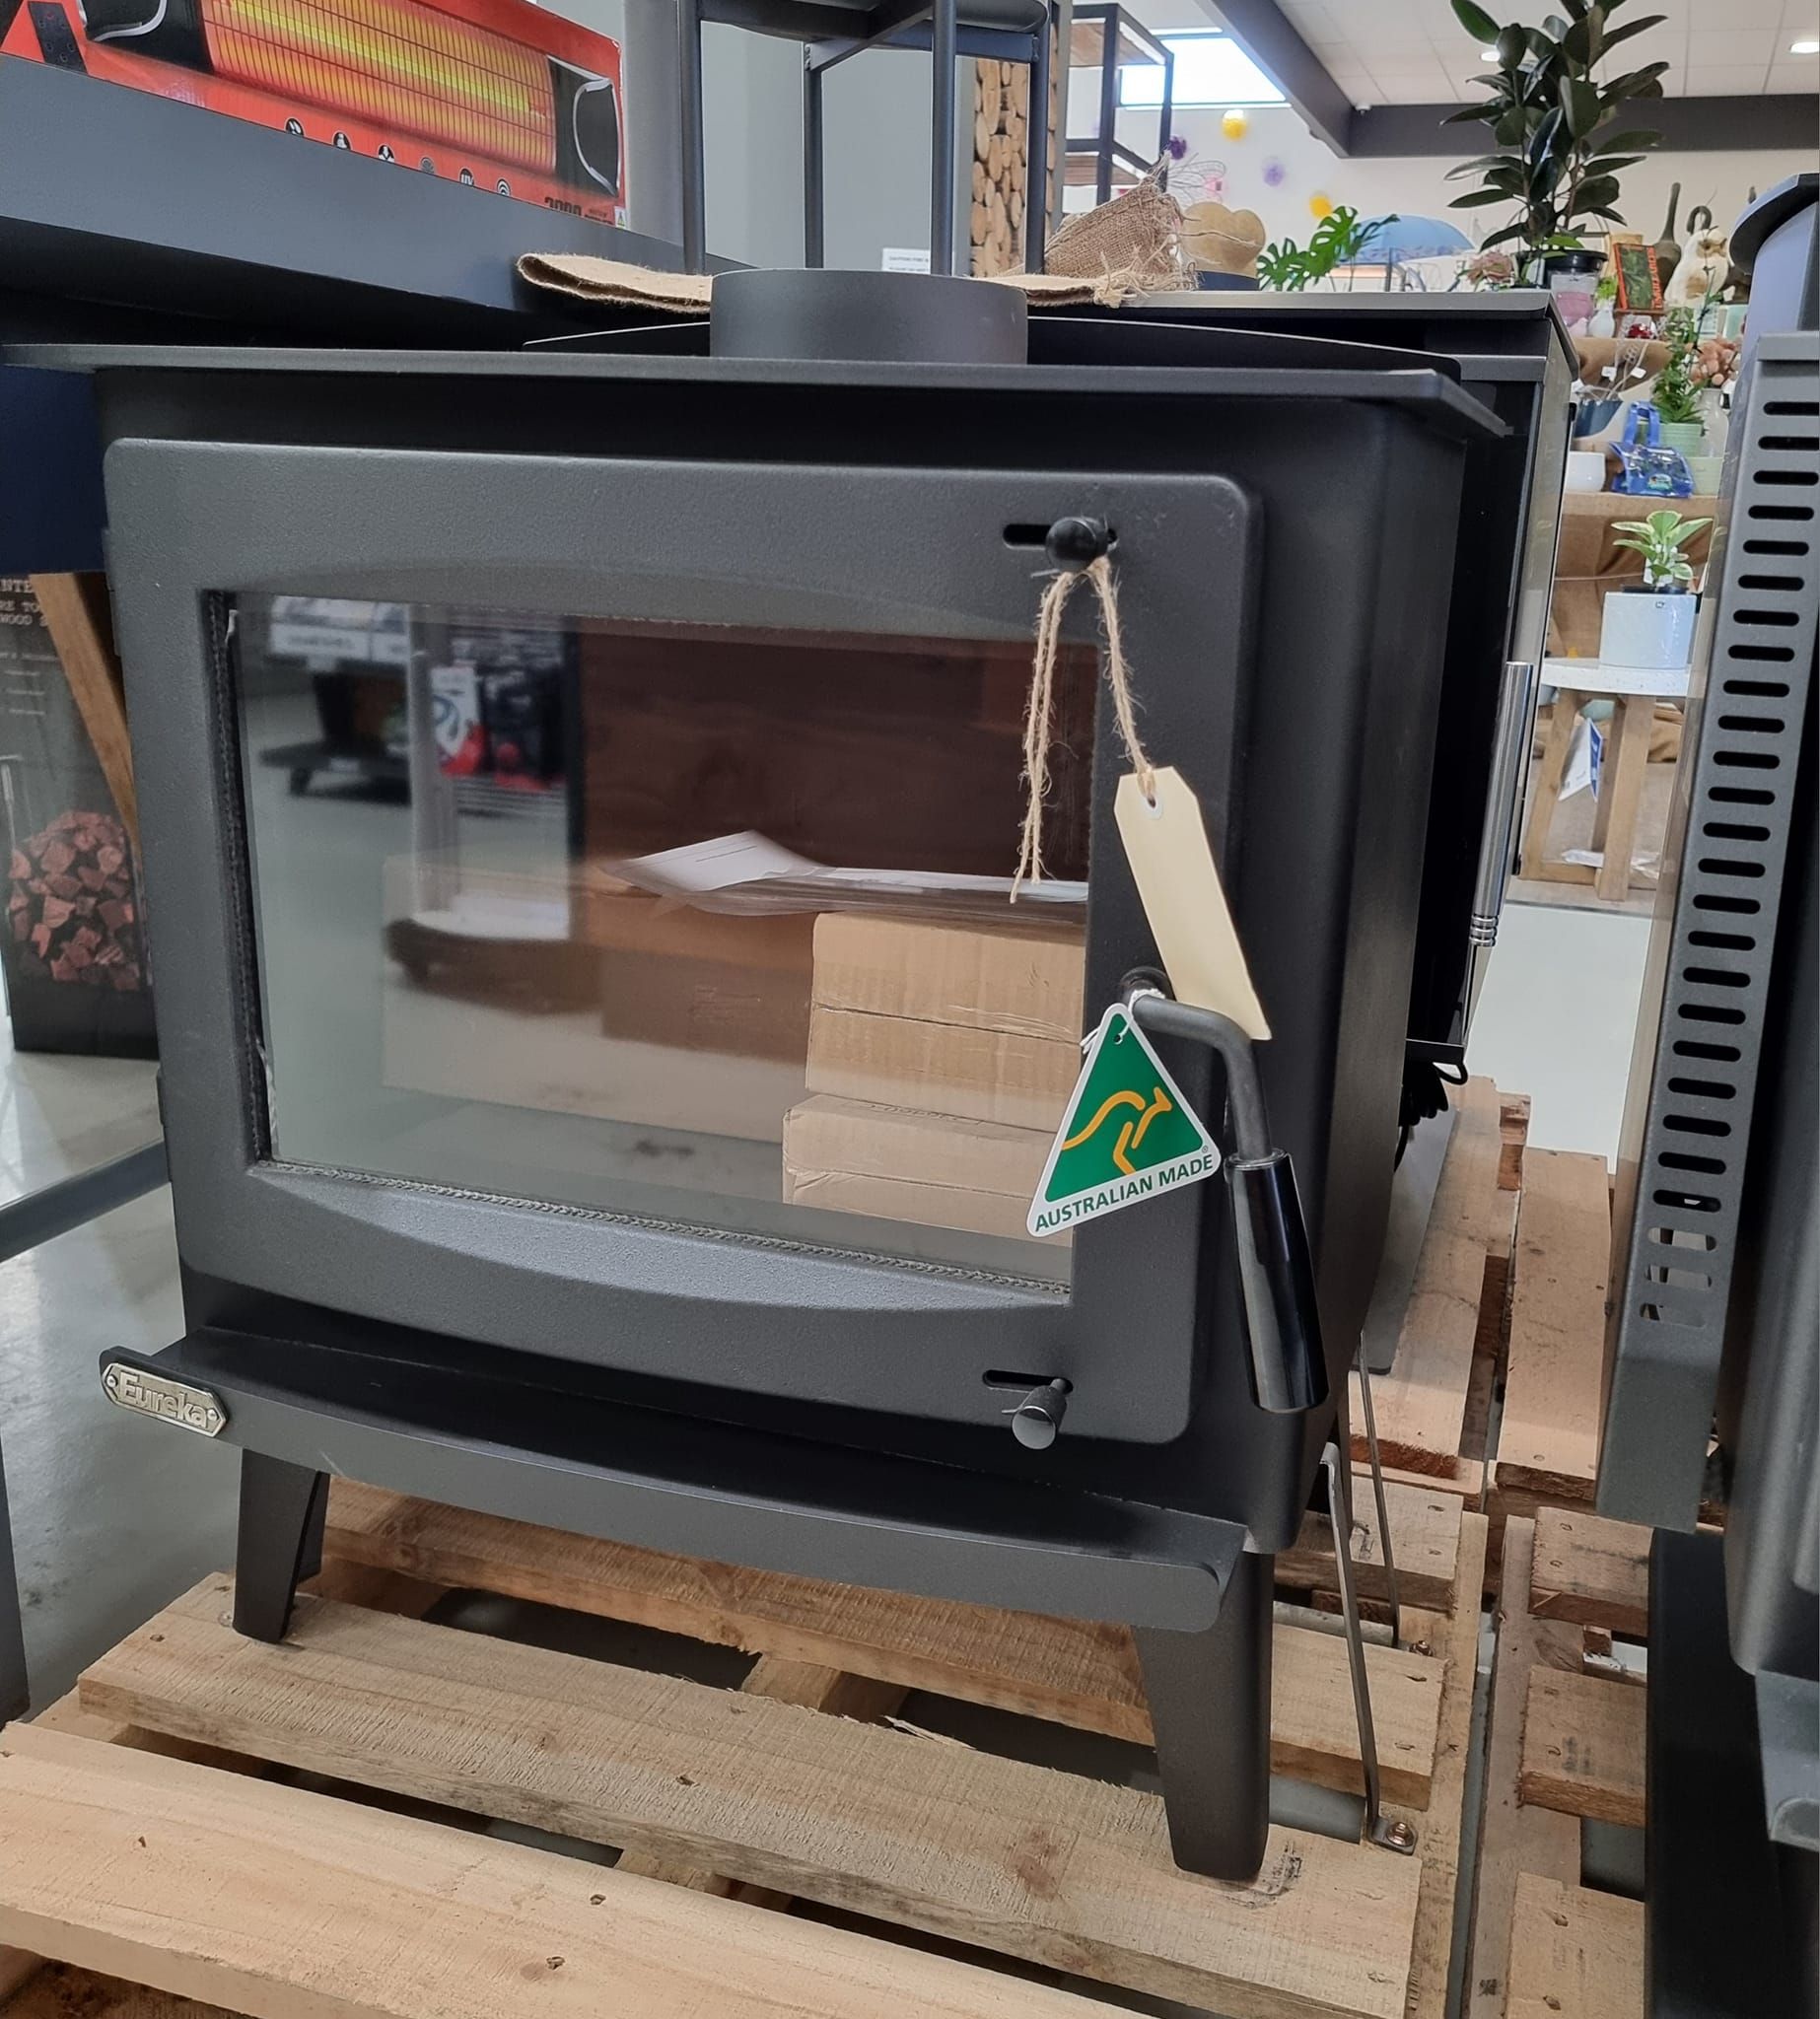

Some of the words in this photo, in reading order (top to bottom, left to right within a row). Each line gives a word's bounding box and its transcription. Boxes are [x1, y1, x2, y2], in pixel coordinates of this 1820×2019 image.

[1035, 1175, 1153, 1231] AUSTRALIAN
[1158, 1154, 1214, 1187] MADE
[119, 1371, 208, 1428] Eureka
